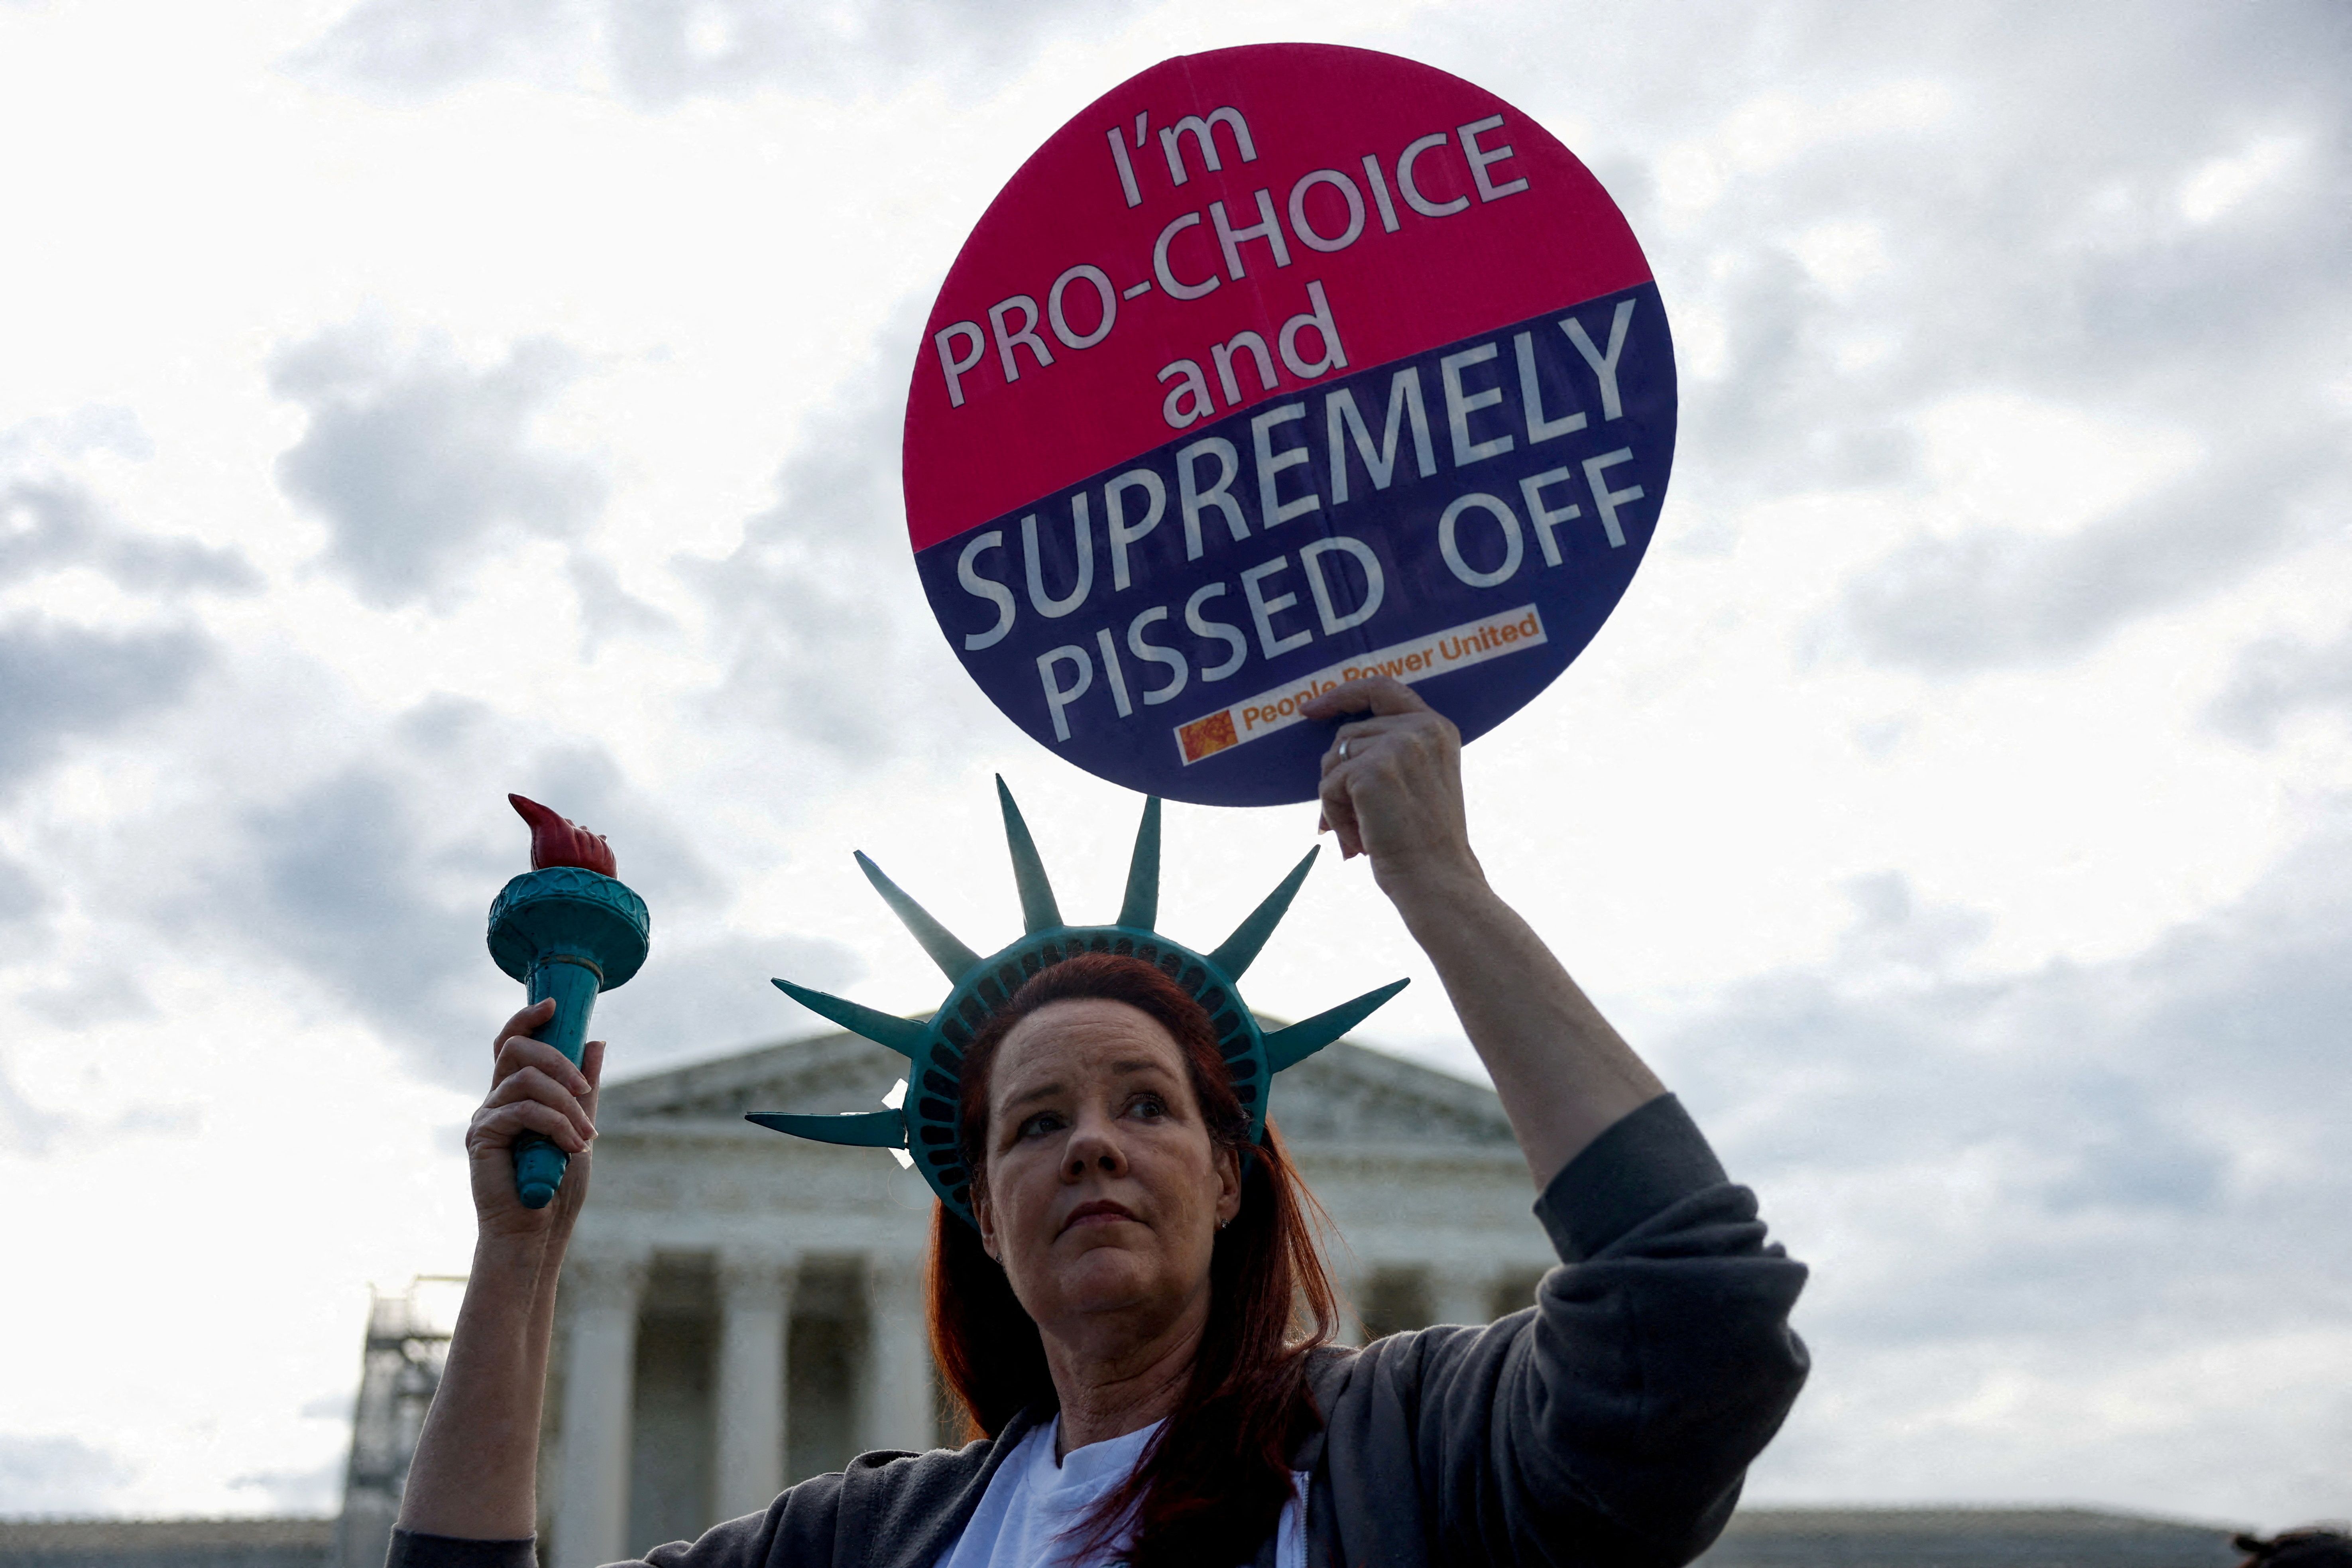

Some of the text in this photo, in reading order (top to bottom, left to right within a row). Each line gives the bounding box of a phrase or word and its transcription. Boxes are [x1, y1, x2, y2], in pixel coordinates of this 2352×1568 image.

[934, 114, 1529, 407] PRO-CHOICE
[1107, 107, 1257, 207] I'm
[1157, 280, 1348, 428] and
[957, 298, 1636, 651] SUPREMELY
[1036, 447, 1644, 743] PISSED OFF
[1438, 612, 1540, 661] United
